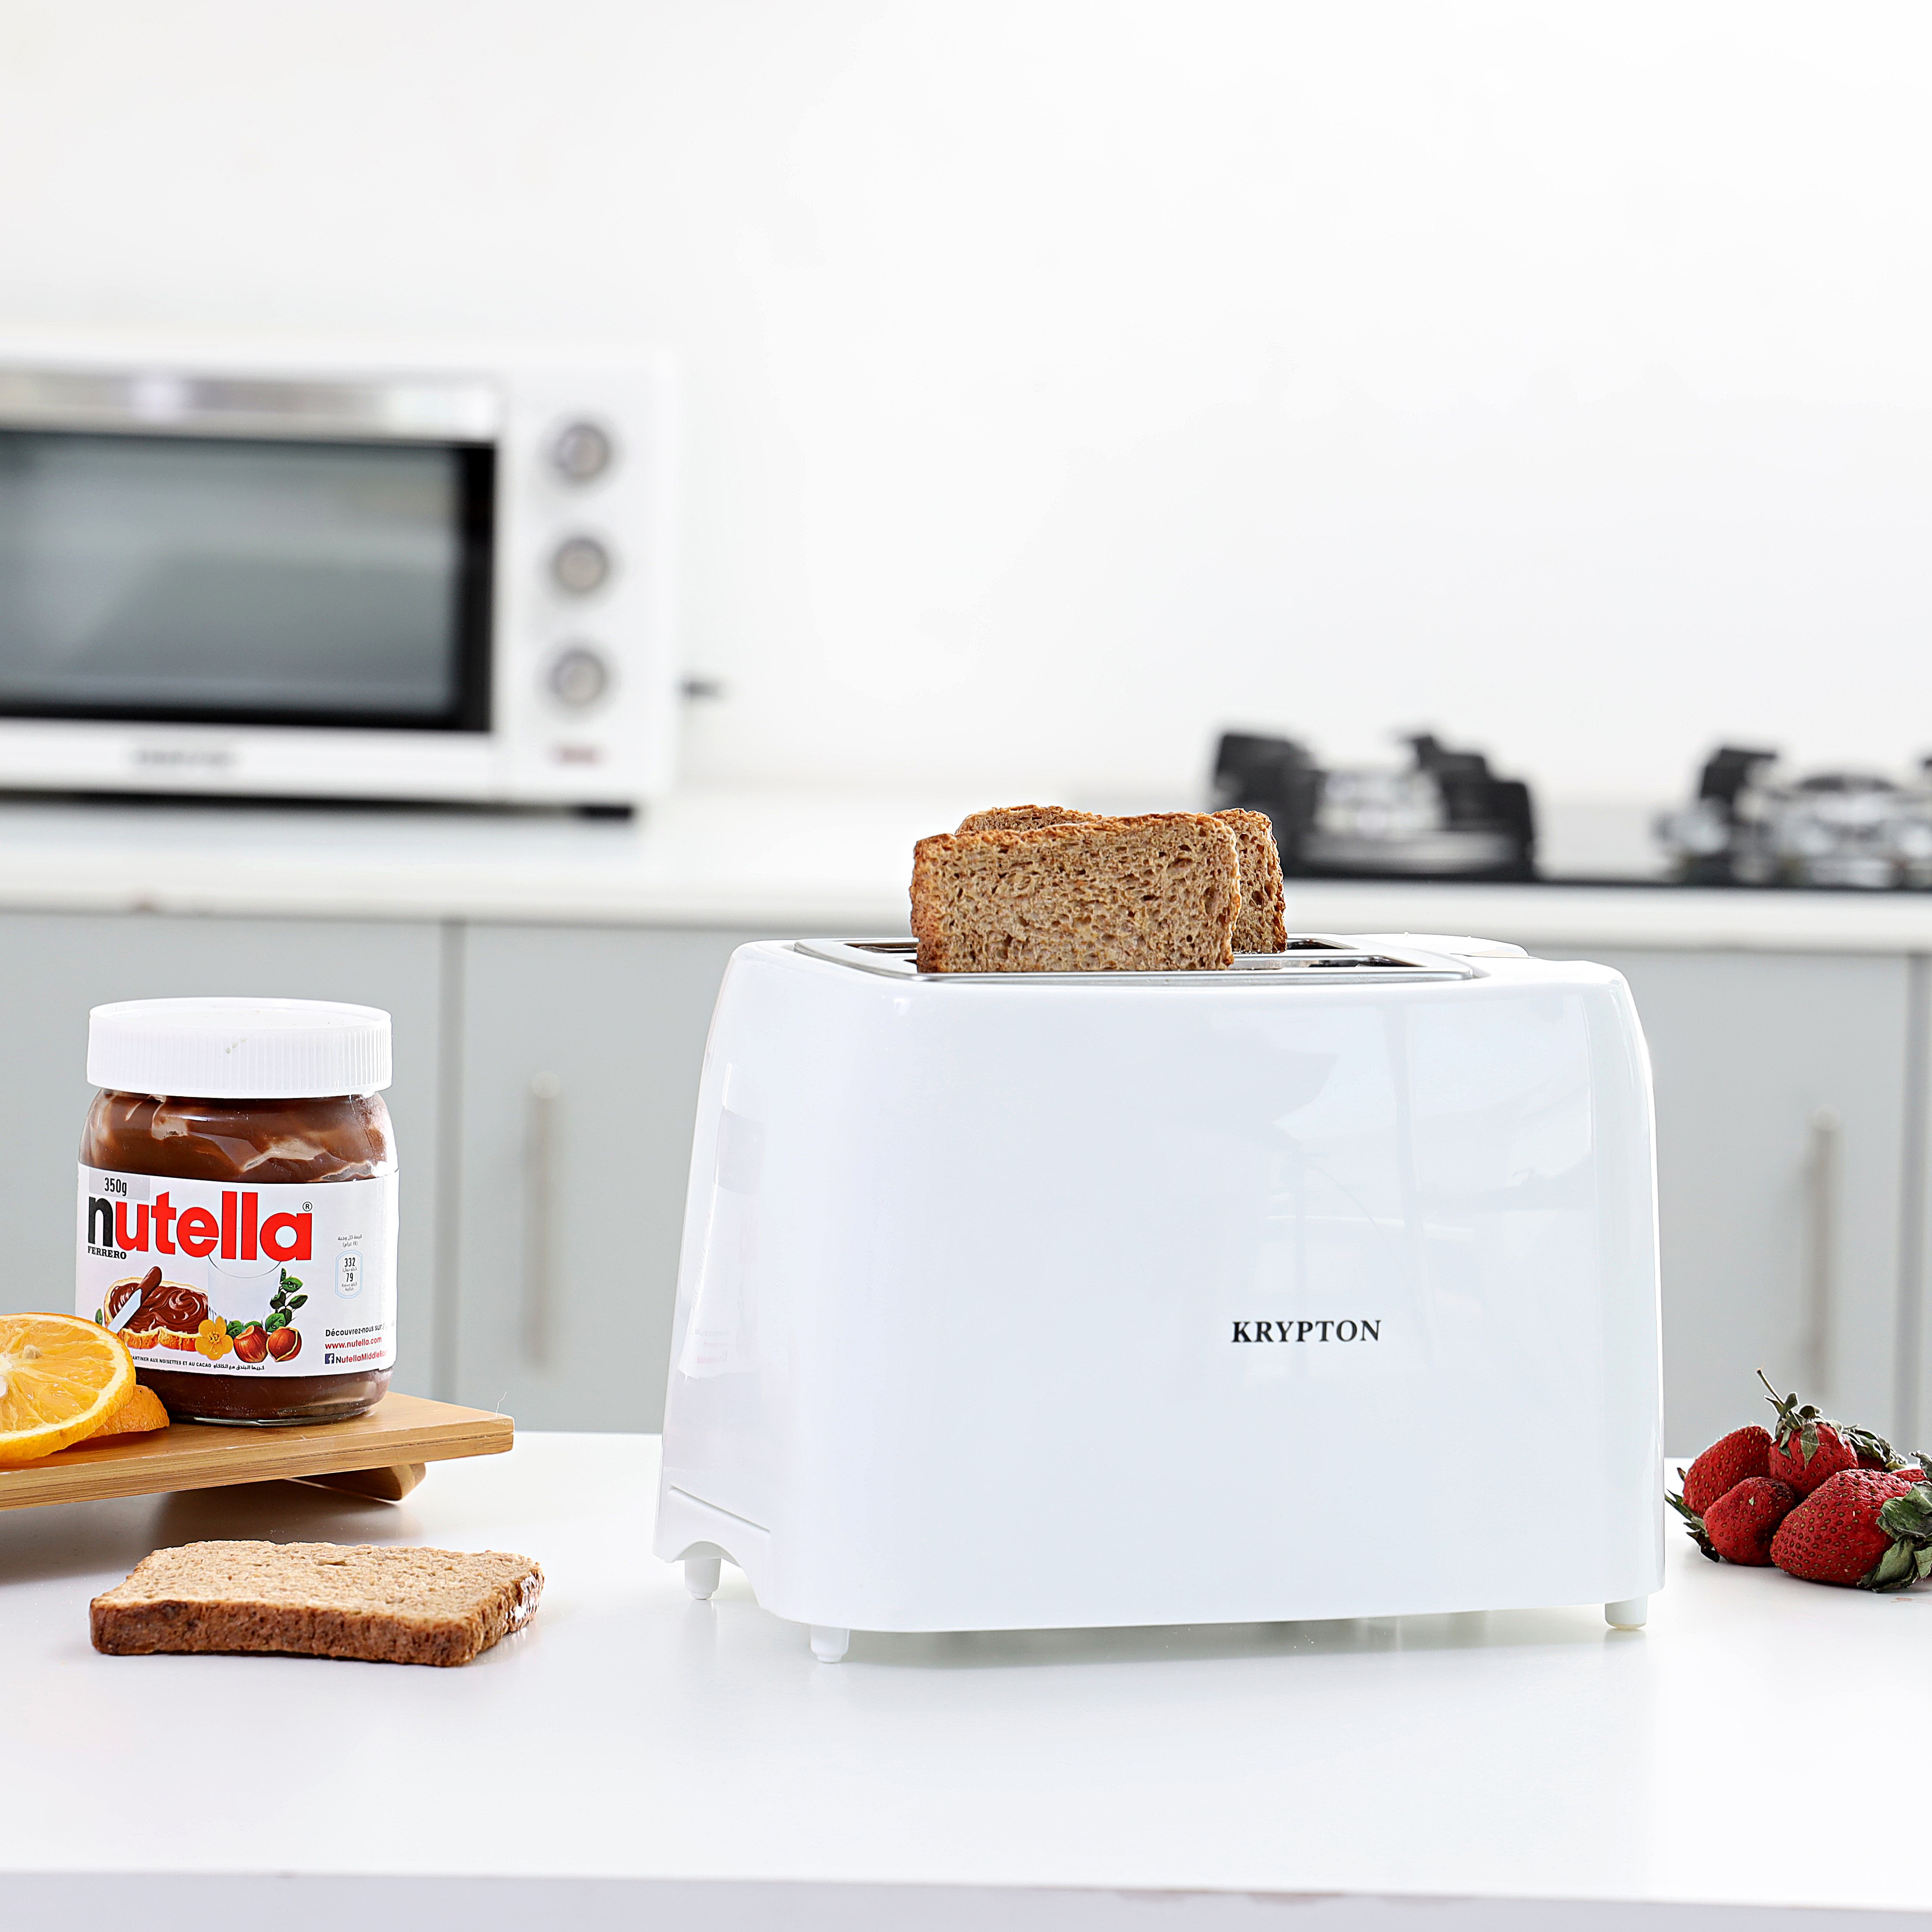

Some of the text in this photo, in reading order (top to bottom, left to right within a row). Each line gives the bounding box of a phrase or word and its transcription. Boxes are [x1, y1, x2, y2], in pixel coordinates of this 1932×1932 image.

[104, 1177, 127, 1196] 350g
[88, 1191, 312, 1262] nutella
[88, 1245, 127, 1260] FERRERO
[345, 1257, 355, 1267] 332
[346, 1272, 353, 1282] 79
[326, 1326, 374, 1337] Découvrez-nous
[1231, 1320, 1381, 1343] KRYPTON
[325, 1337, 382, 1349] www.nutella.com
